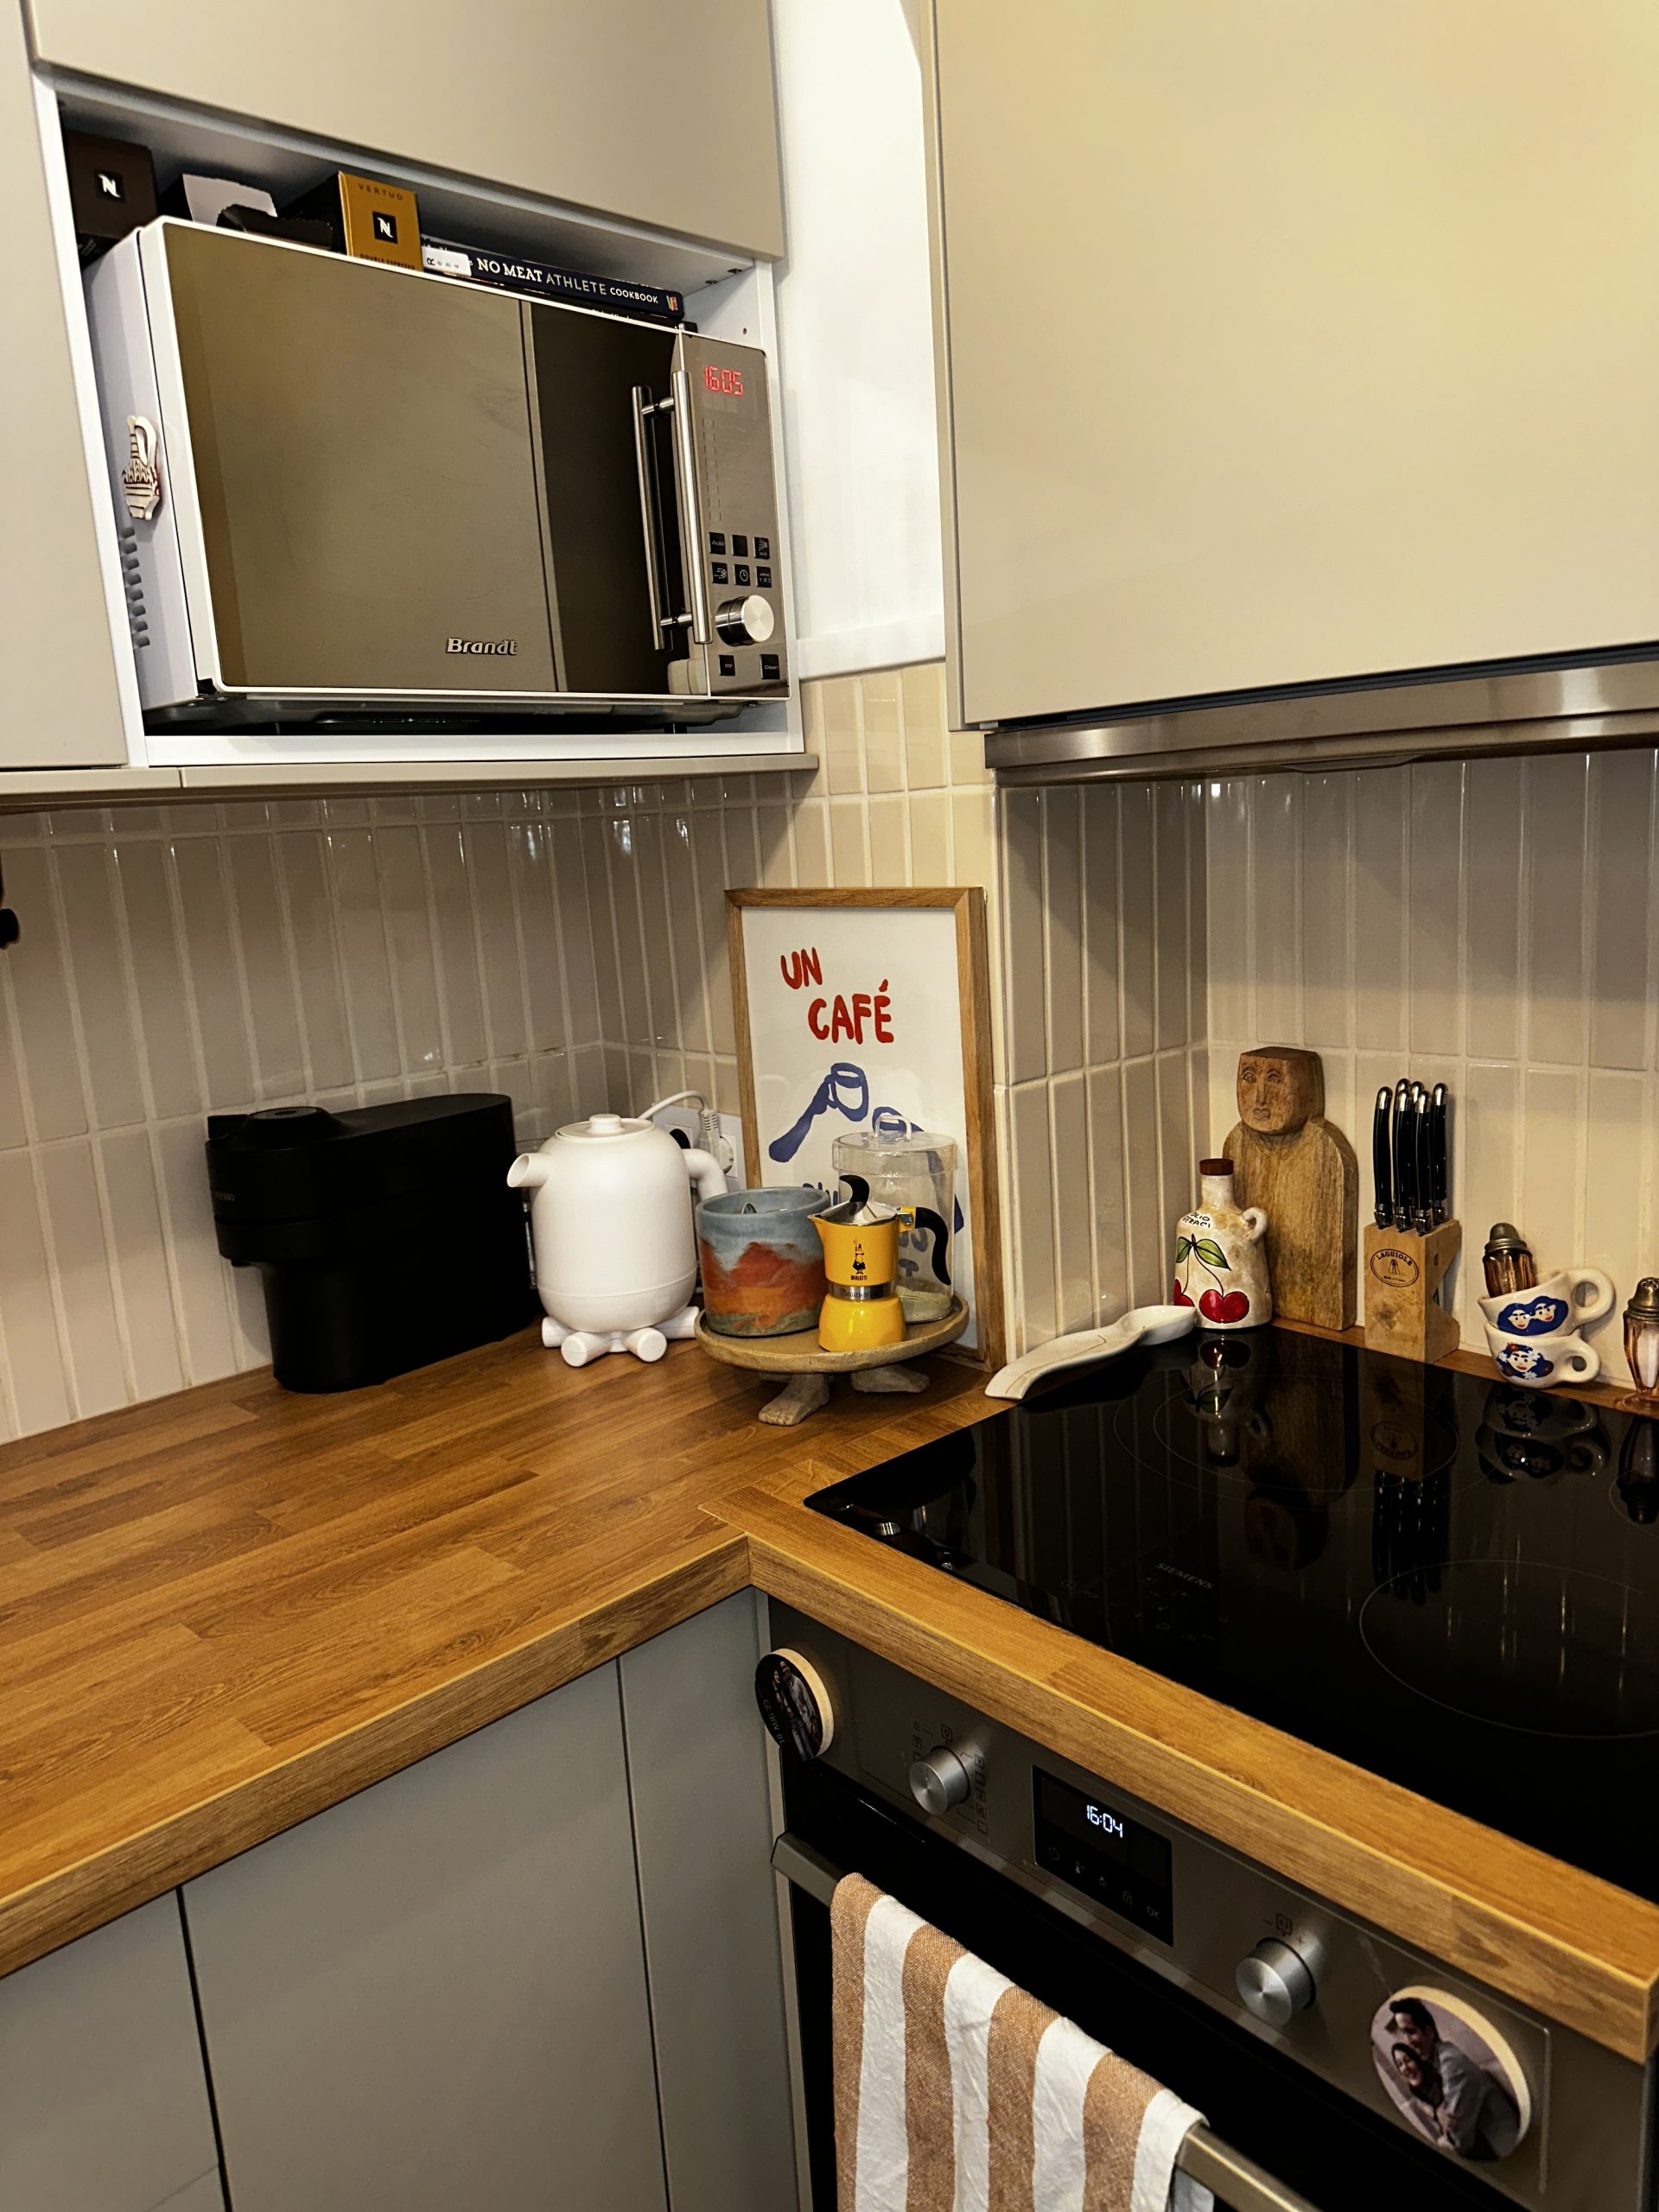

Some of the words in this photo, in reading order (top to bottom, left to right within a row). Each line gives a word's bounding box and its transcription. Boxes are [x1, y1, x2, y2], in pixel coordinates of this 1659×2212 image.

[359, 183, 404, 200] VERTUO
[477, 257, 501, 274] NO
[502, 263, 543, 283] MEAT
[546, 272, 607, 296] ATHLETE
[609, 287, 659, 304] COOKBOOK
[446, 637, 518, 656] Brandt
[780, 947, 823, 989] UN
[808, 978, 894, 1045] CAFÉ
[1376, 1251, 1414, 1267] LAGUIOLE
[1155, 1562, 1215, 1589] SIEMENS
[1086, 1804, 1123, 1839] 16:04
